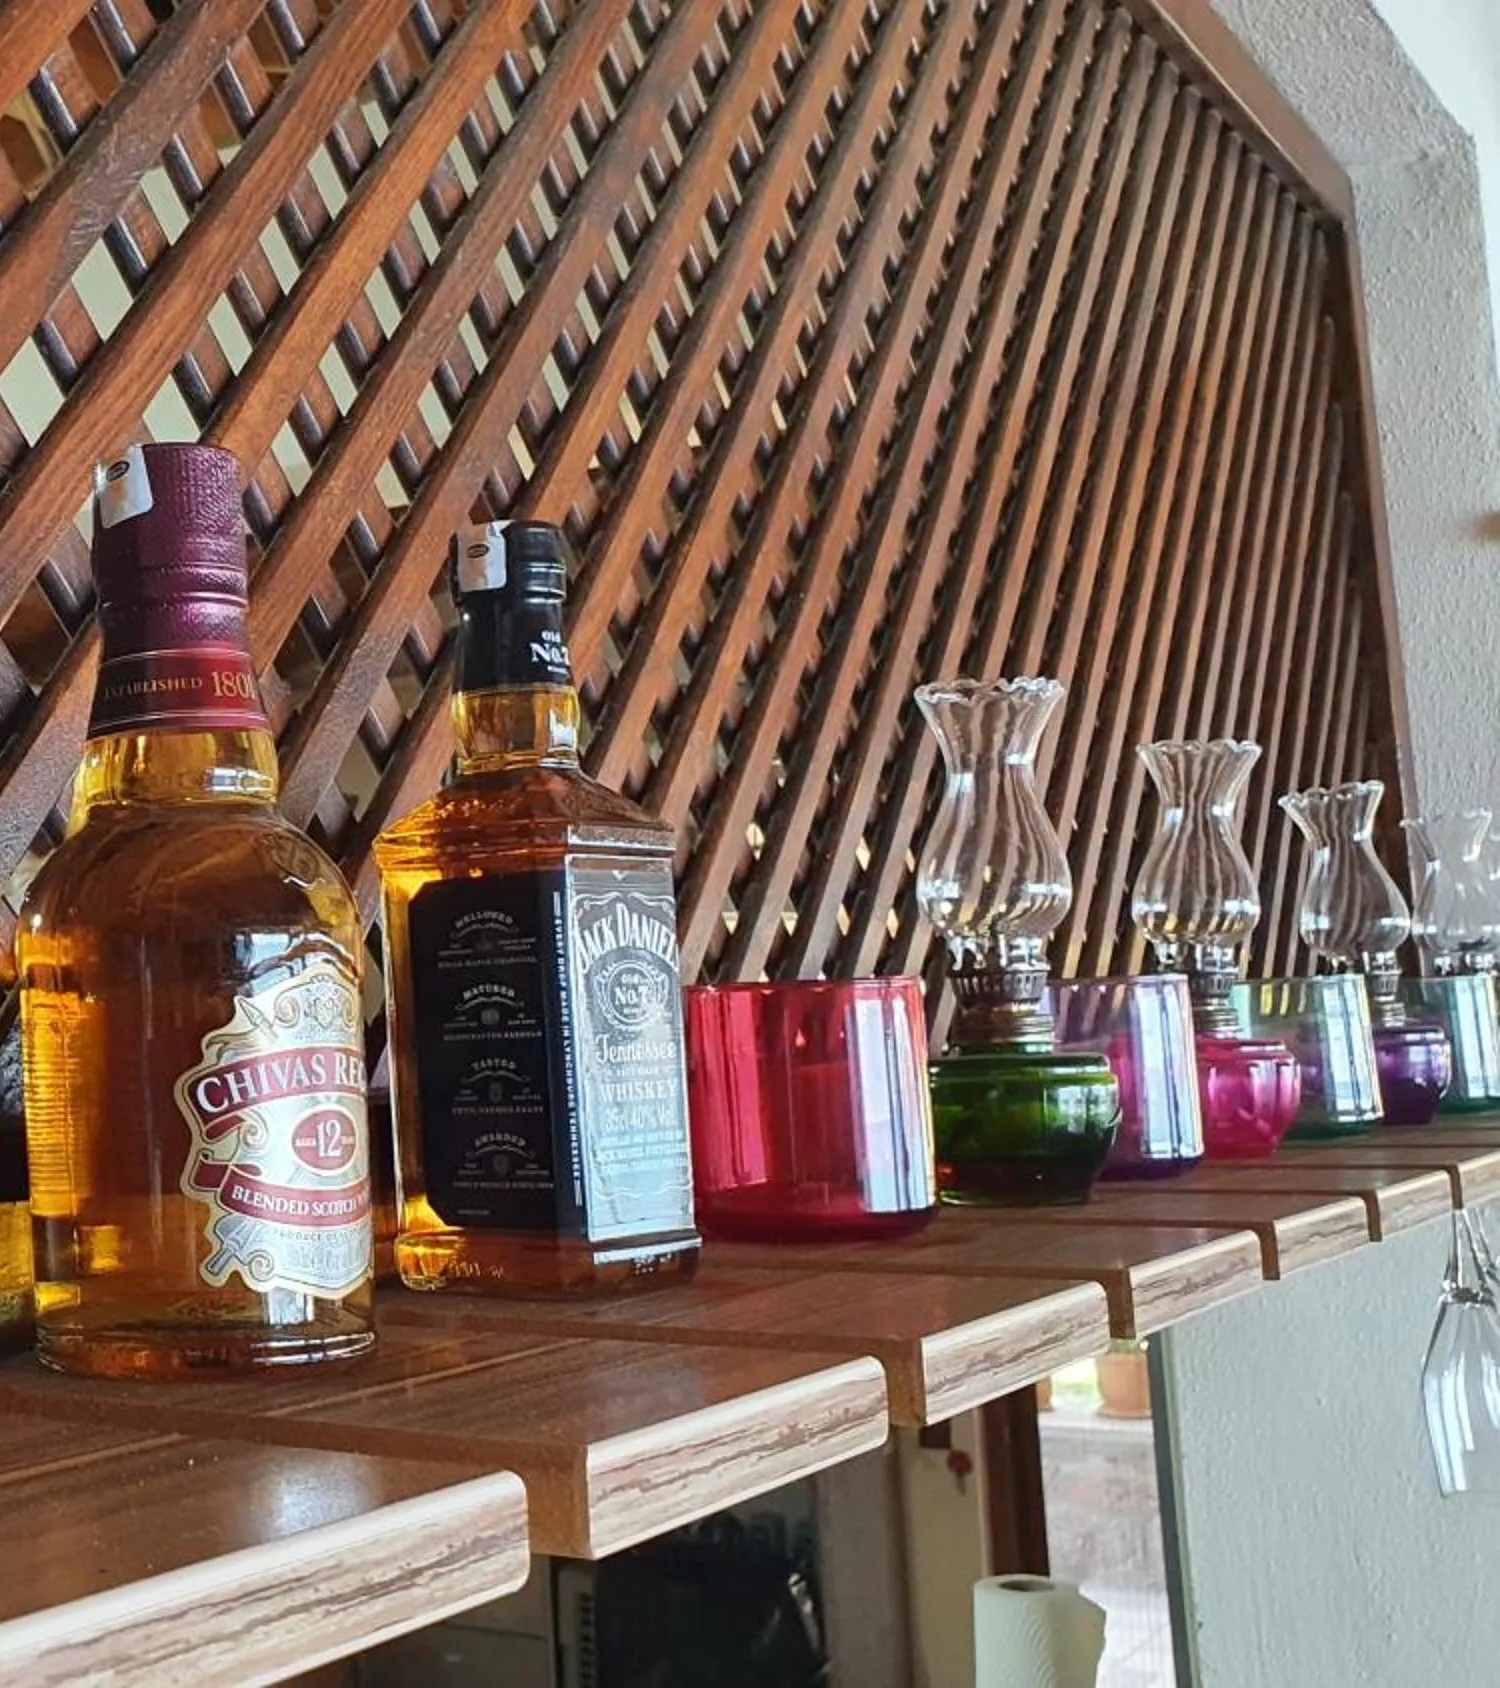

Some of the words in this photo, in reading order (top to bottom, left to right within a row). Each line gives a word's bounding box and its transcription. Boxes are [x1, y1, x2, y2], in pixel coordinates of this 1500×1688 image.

[105, 676, 203, 700] ESTABLISHED
[575, 913, 618, 975] JACK
[595, 1034, 677, 1064] Tennessee
[196, 1053, 326, 1114] CHIVAS
[601, 1078, 678, 1103] WHISKEY
[317, 1119, 342, 1158] 12
[232, 1185, 309, 1216] BLENDED
